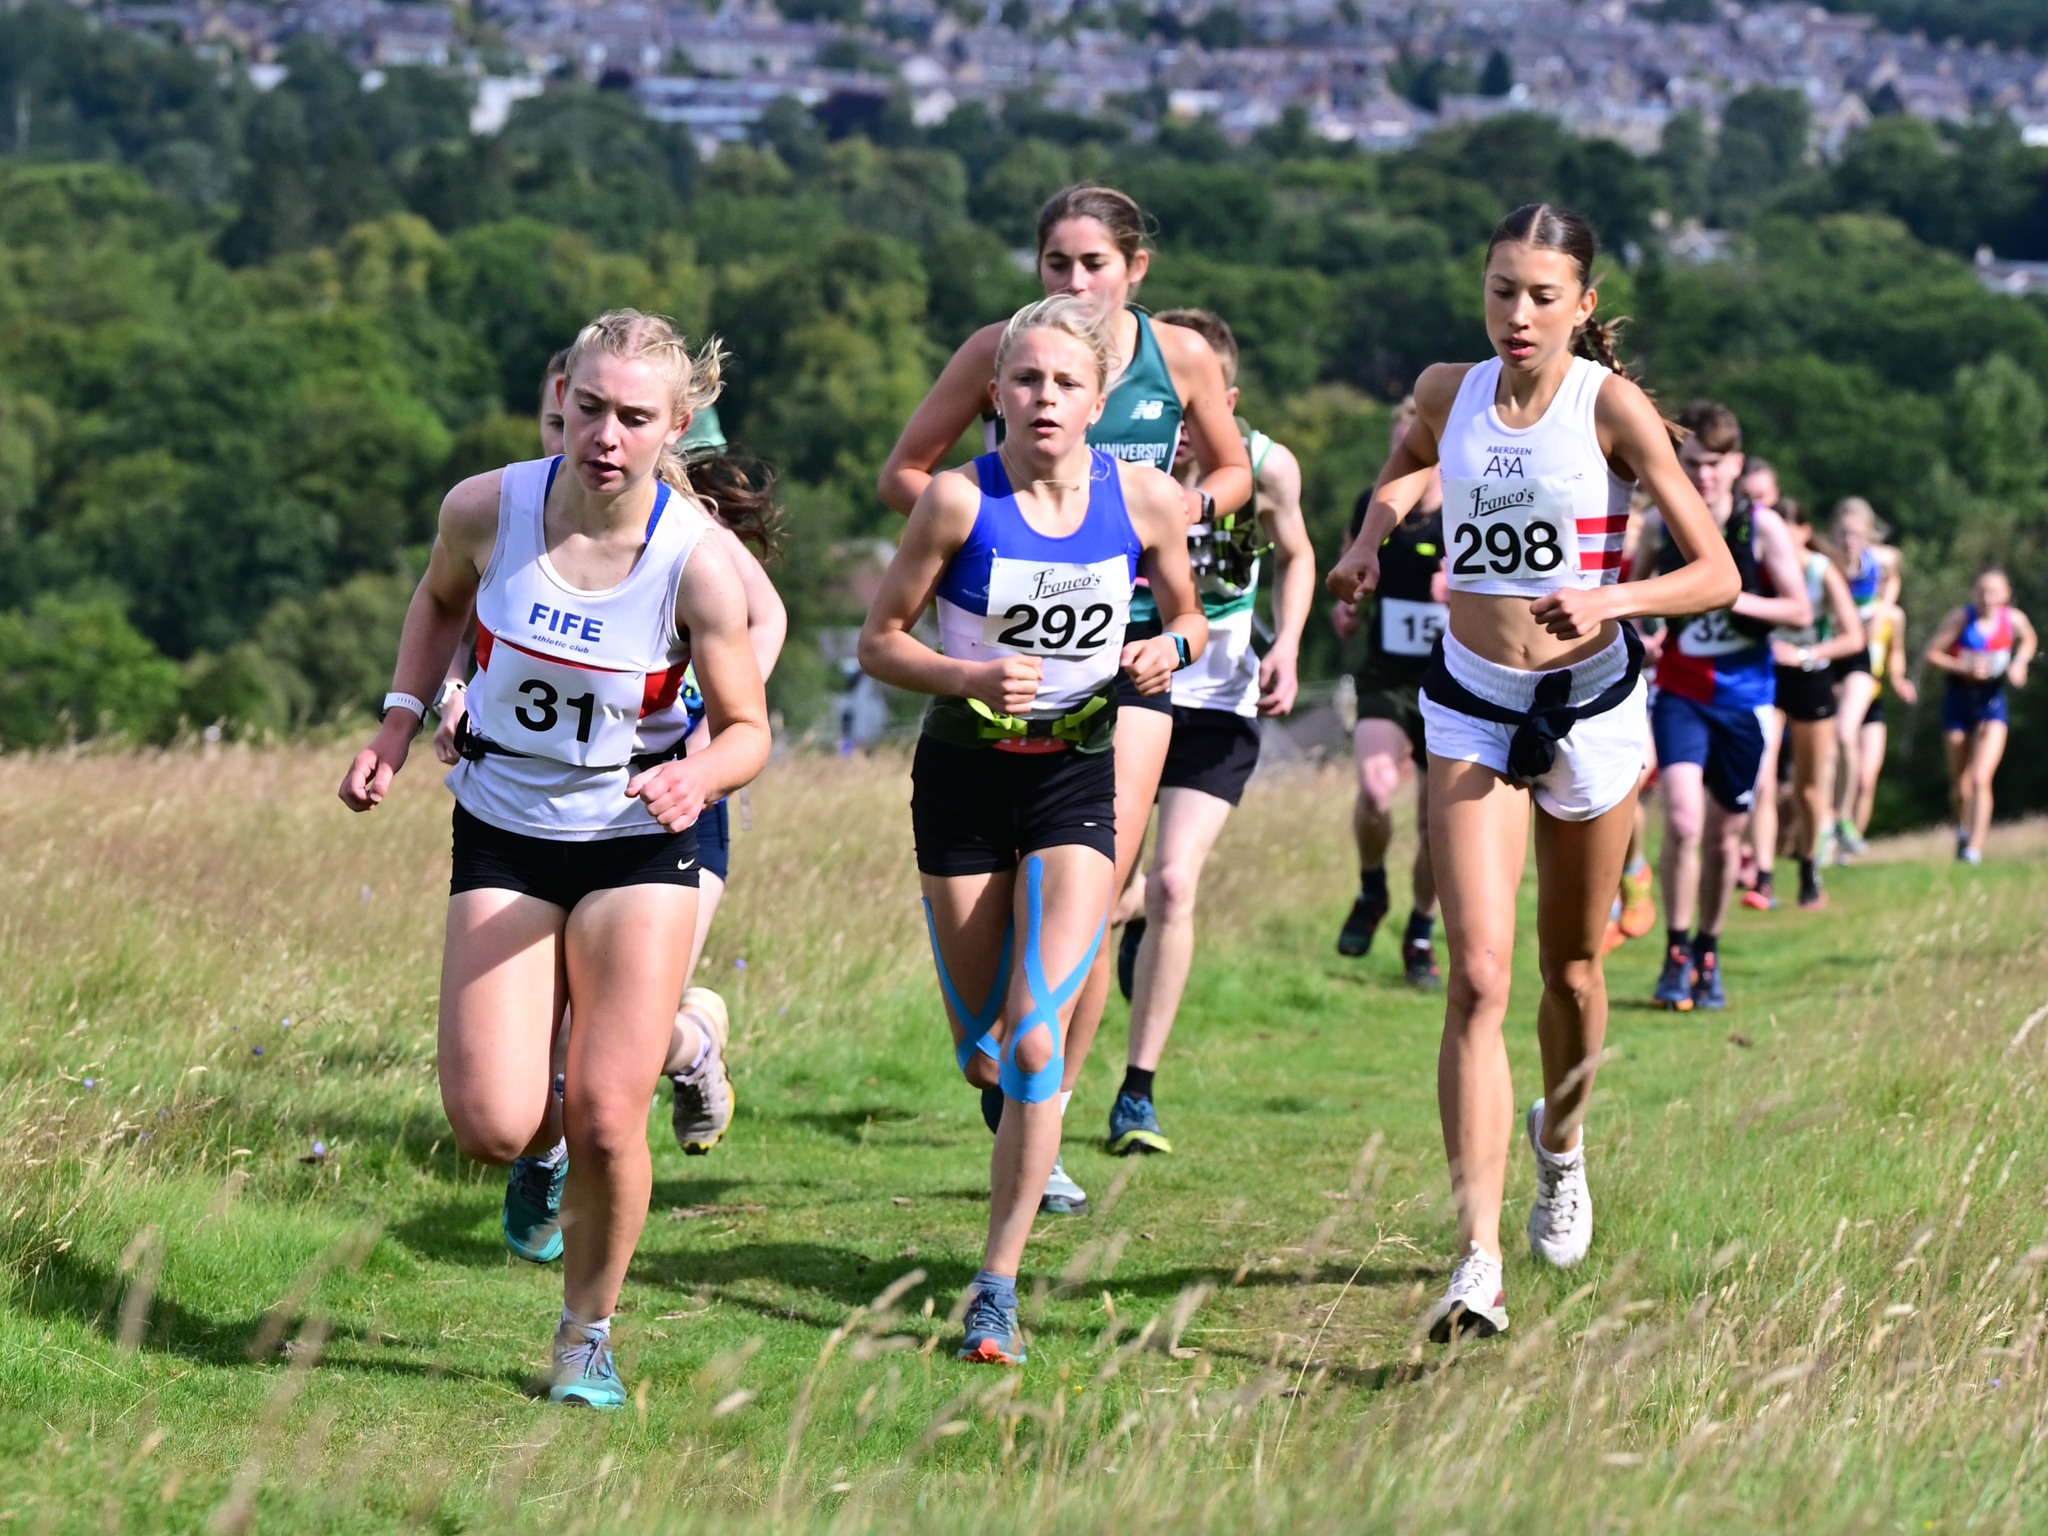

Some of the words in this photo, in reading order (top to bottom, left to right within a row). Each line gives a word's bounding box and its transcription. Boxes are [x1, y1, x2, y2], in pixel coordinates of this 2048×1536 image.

[1487, 446, 1532, 456] ABERDEEN
[1469, 484, 1535, 519] Franco's
[1453, 521, 1563, 575] 298
[1029, 568, 1102, 600] Franco's
[528, 602, 603, 643] FIFE
[997, 603, 1113, 649] 292
[532, 634, 567, 648] athletic
[569, 645, 589, 654] club
[515, 679, 595, 743] 31
